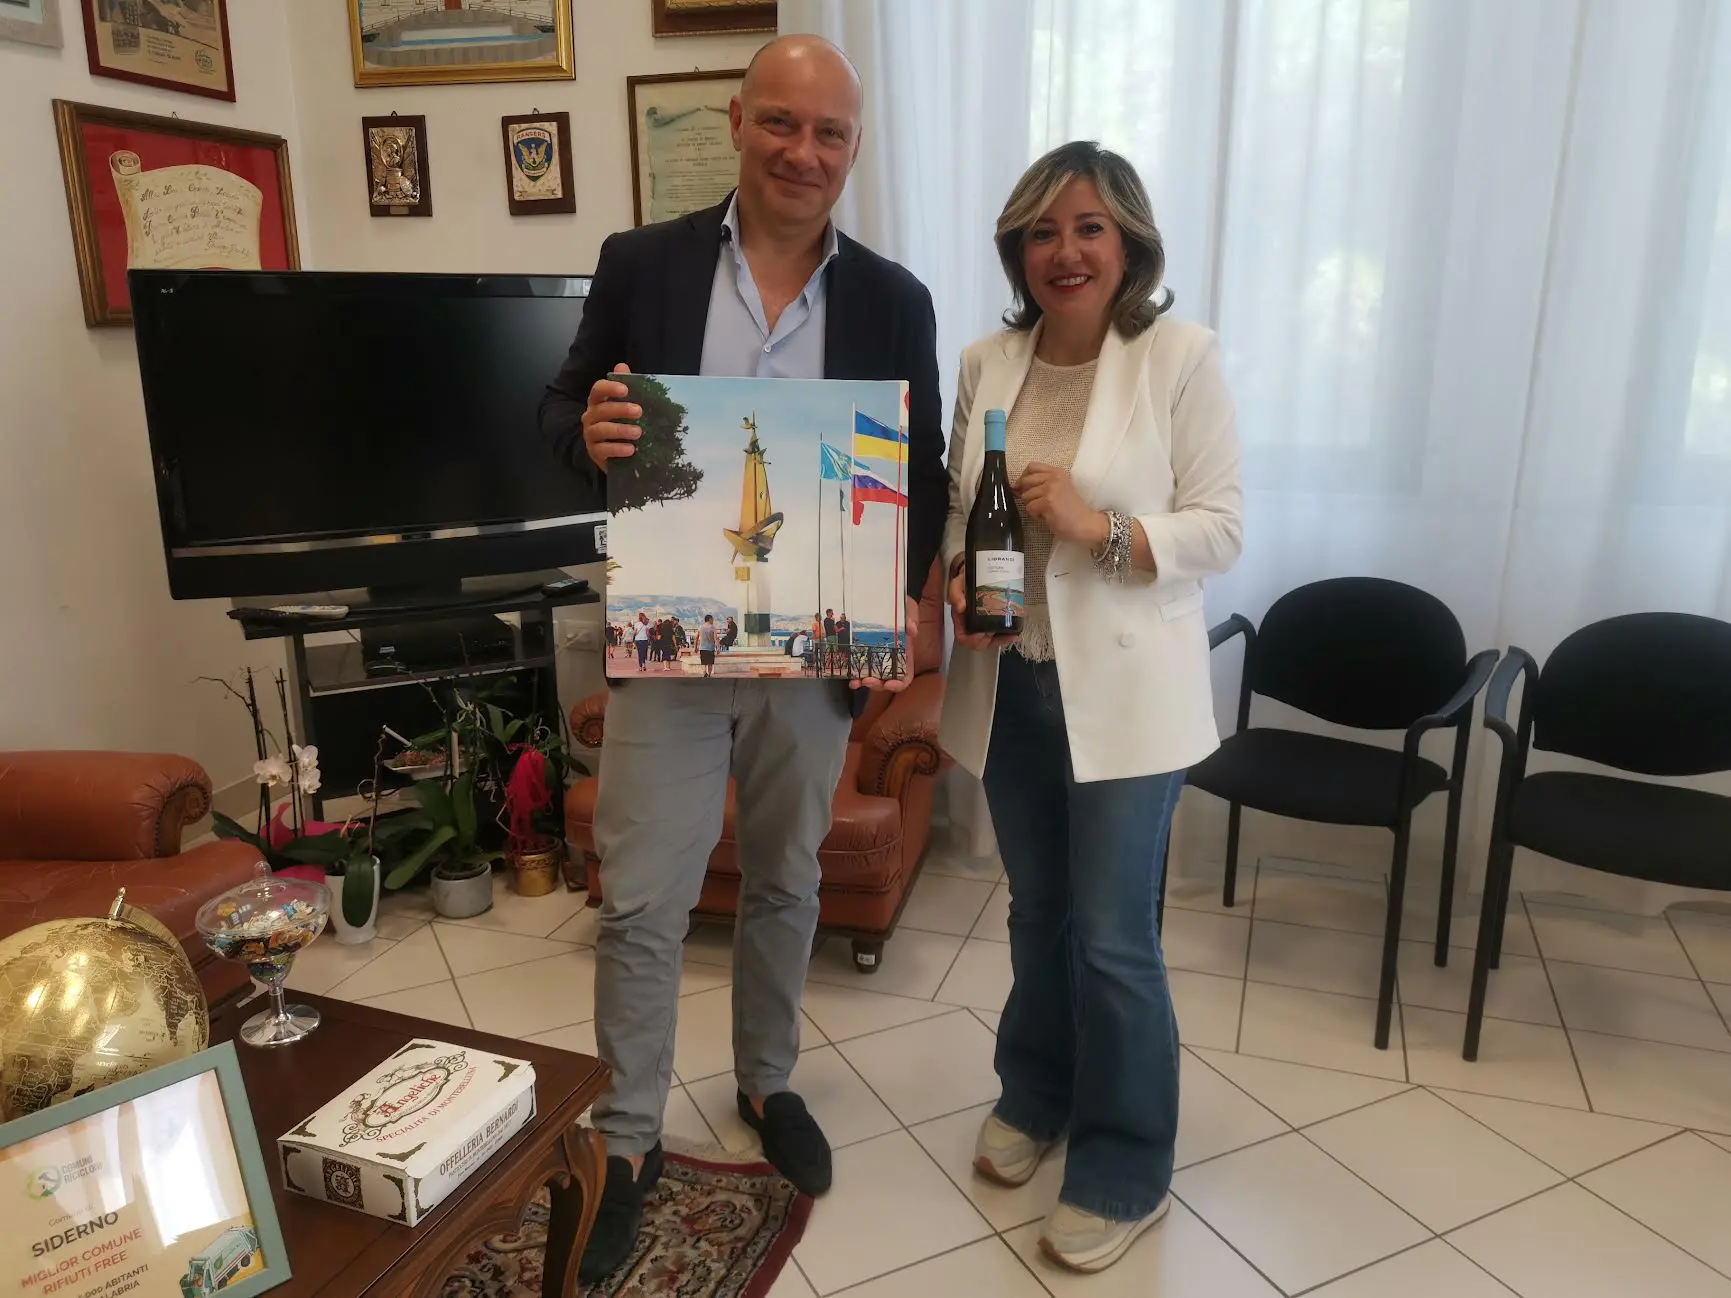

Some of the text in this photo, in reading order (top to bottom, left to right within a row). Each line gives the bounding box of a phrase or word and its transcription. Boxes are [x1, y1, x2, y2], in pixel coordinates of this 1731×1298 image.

[373, 1072, 441, 1118] Angeliche
[429, 1107, 440, 1116] DI
[439, 1131, 484, 1176] OFFELLERIA
[486, 1100, 519, 1138] BERNARDI
[62, 1155, 93, 1174] COMUNI
[31, 1211, 119, 1258] SIDERNO
[20, 1228, 143, 1288] MIGLIOR COMUNE
[43, 1249, 129, 1295] RIFIUTI FREE
[105, 1263, 149, 1289] ABITANTI
